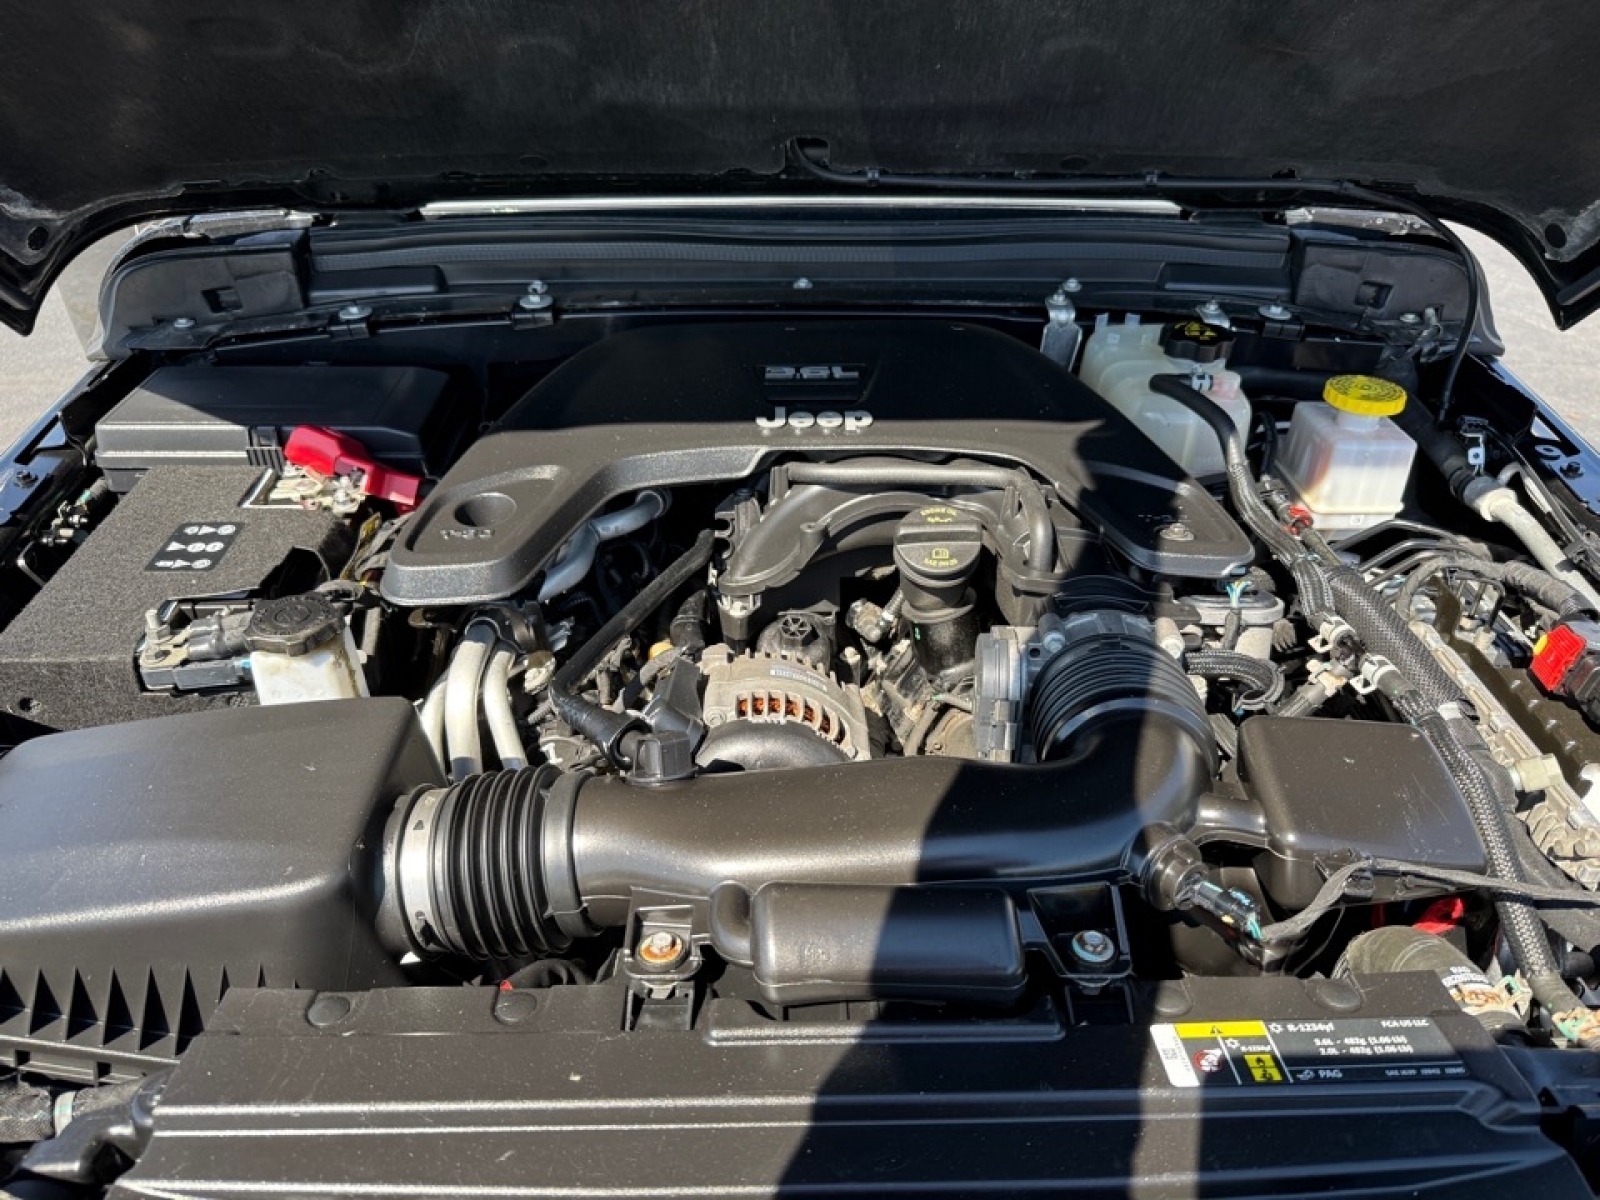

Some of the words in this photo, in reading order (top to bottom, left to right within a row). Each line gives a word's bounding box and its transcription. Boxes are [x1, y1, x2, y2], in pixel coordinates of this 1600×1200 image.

[764, 366, 859, 379] 3.6L
[755, 406, 873, 431] Jeep
[1286, 1022, 1335, 1033] R-1234yf
[1318, 1069, 1343, 1079] PAG
